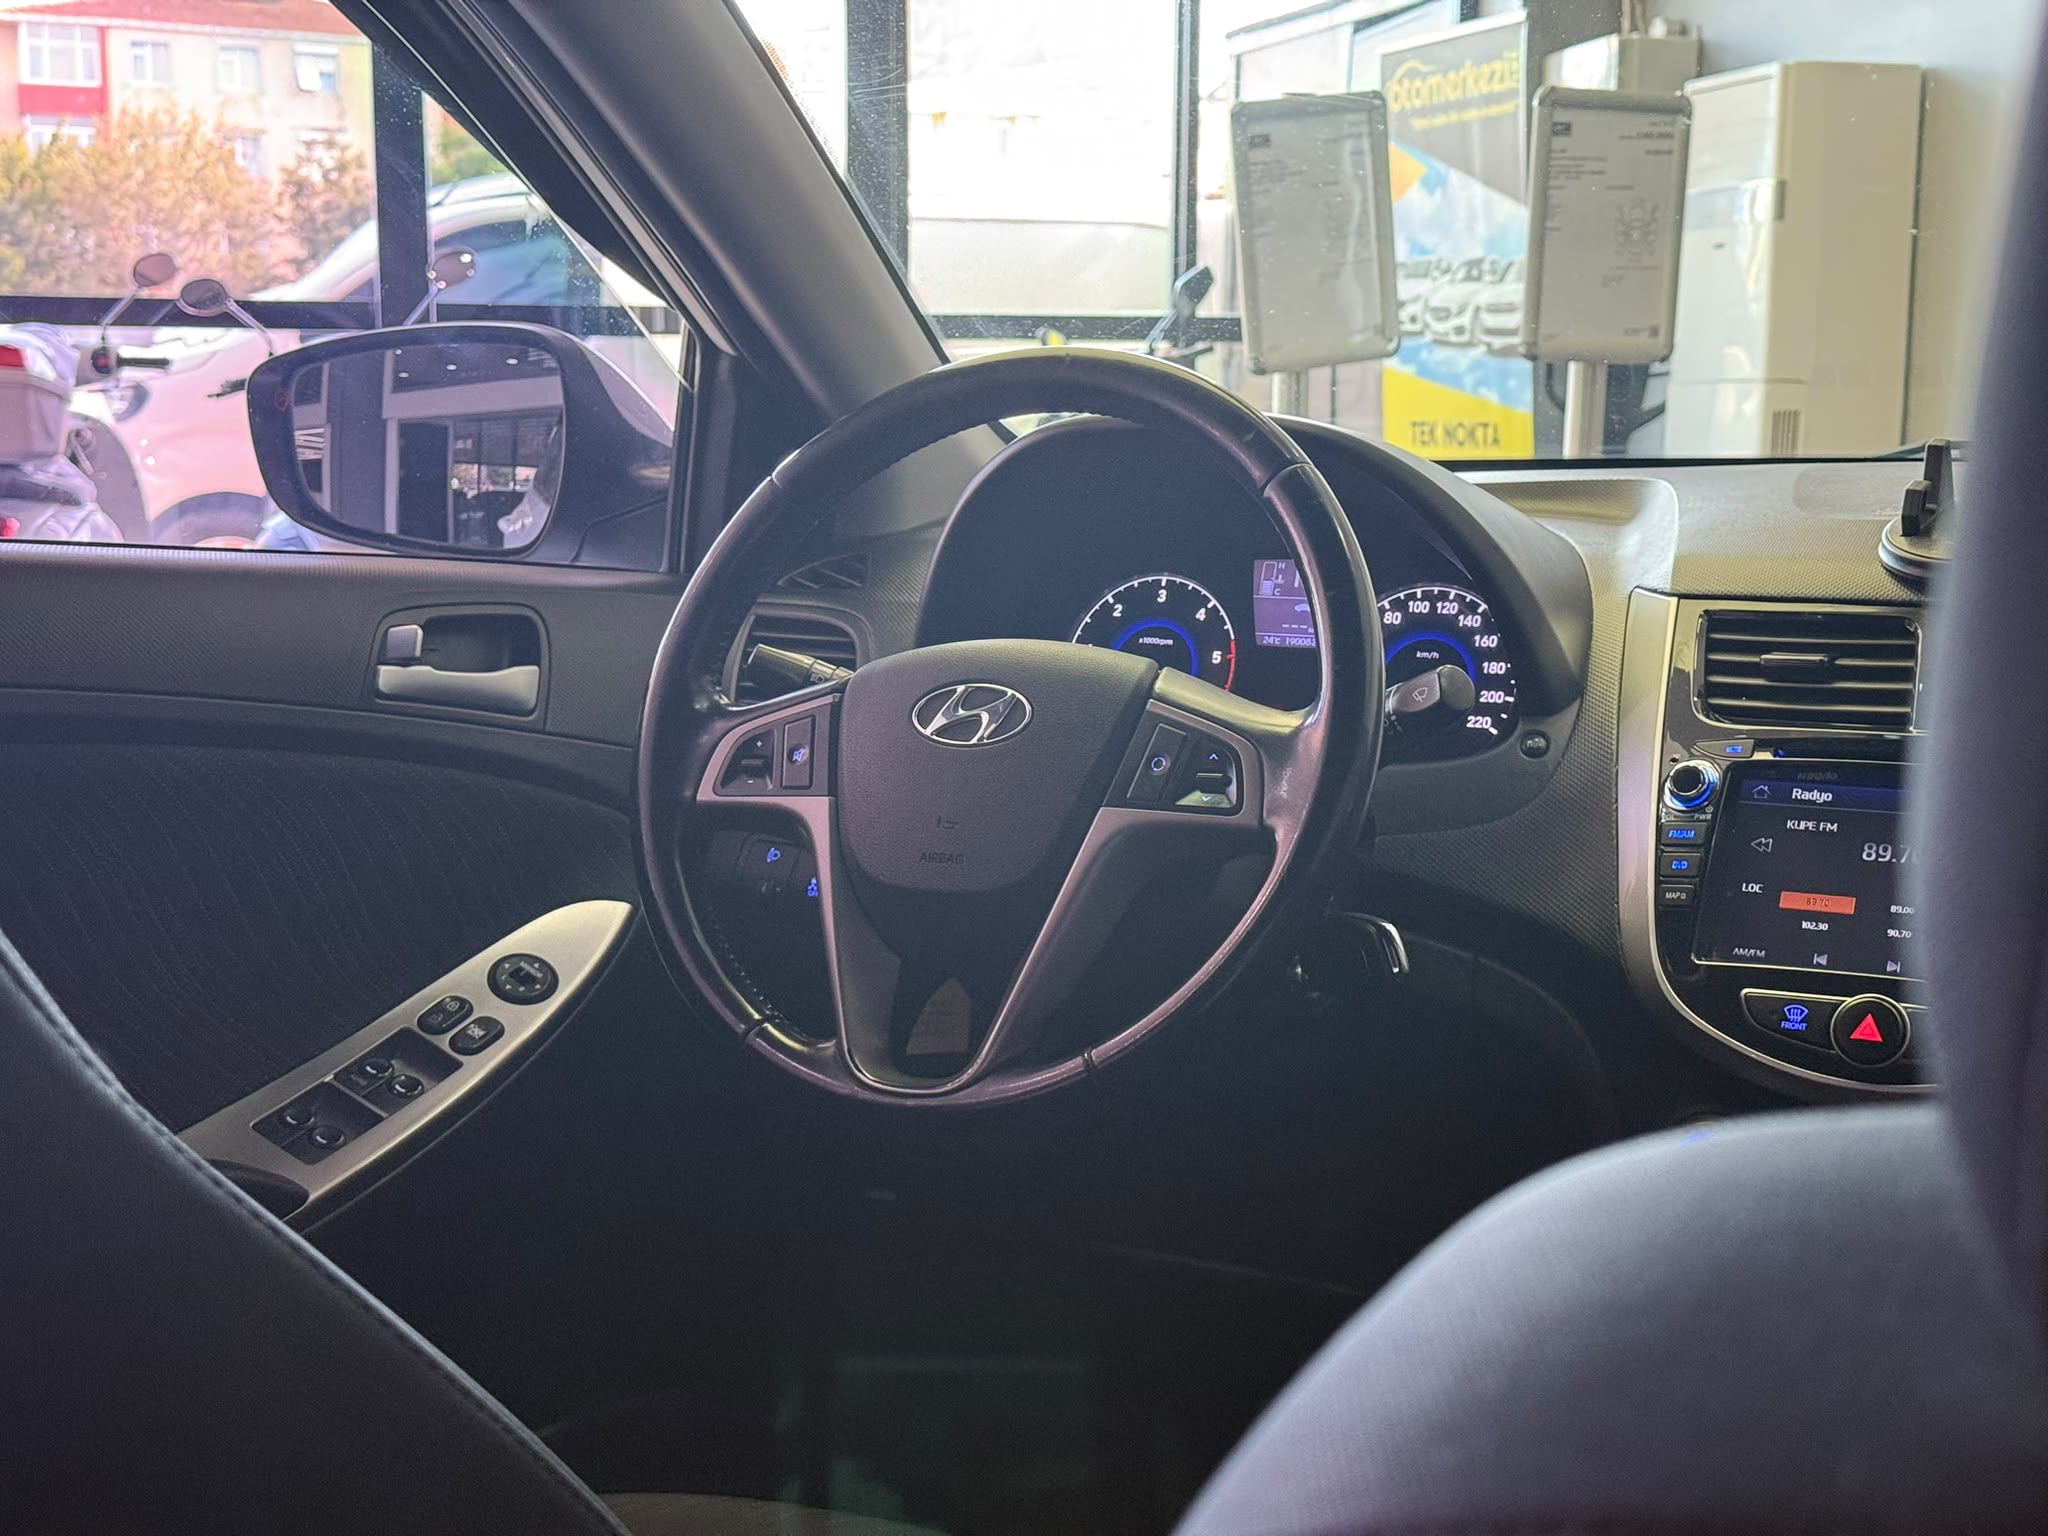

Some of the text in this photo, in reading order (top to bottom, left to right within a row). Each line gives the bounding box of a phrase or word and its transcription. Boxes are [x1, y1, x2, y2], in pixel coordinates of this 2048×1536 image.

[1411, 421, 1500, 449] TEK NOKTA
[1157, 589, 1168, 602] 3
[1112, 604, 1123, 617] 2
[1408, 601, 1430, 613] 100
[1437, 602, 1459, 614] 120
[1195, 608, 1206, 621] 4
[1383, 612, 1402, 625] 80
[1458, 615, 1482, 627] 140
[1474, 635, 1498, 647] 160
[1211, 651, 1222, 663] 5
[1416, 651, 1440, 659] km/h
[1482, 662, 1506, 674] 180
[1479, 691, 1505, 703] 200
[1466, 716, 1492, 728] 220
[1792, 788, 1833, 803] Radyo
[1787, 819, 1838, 832] KUPE FM
[1742, 883, 1763, 893] LOC
[1665, 891, 1680, 899] MAP
[1806, 898, 1830, 907] 89.70
[1801, 921, 1829, 931] 102.30
[1886, 929, 1912, 939] 90.70
[1780, 1021, 1807, 1031] FRONT
